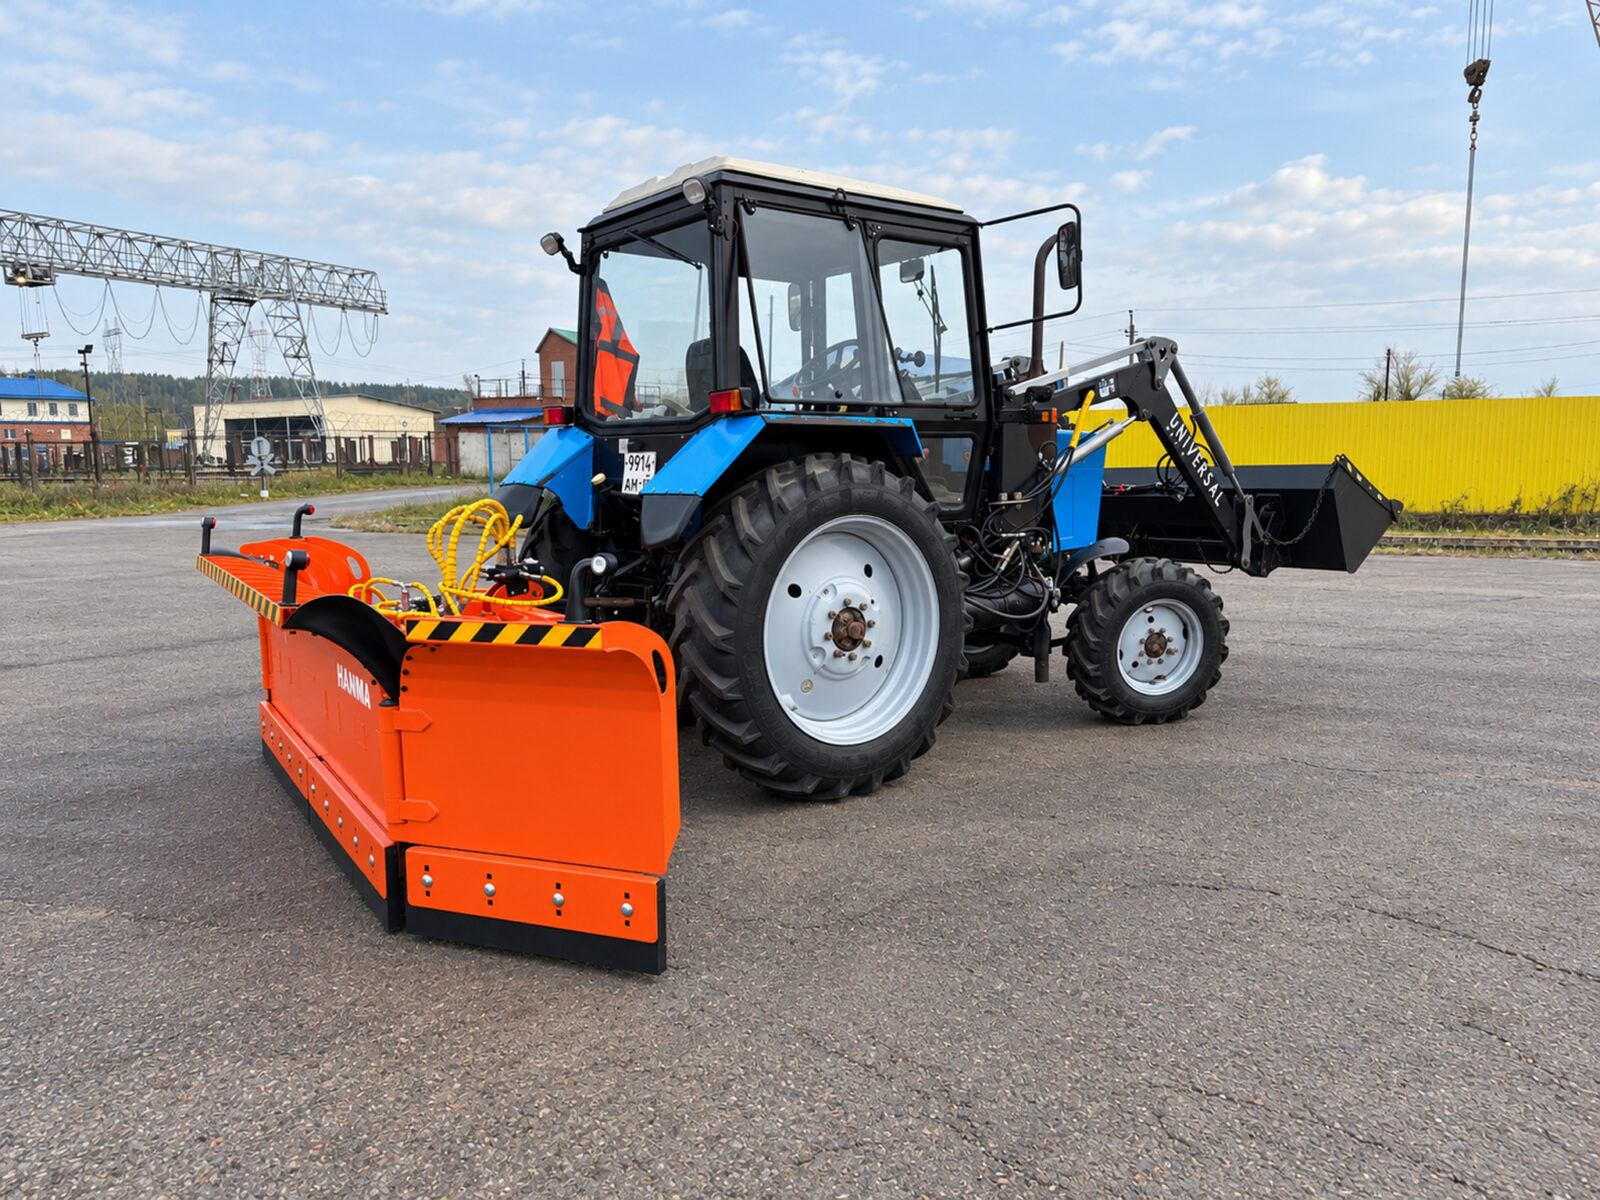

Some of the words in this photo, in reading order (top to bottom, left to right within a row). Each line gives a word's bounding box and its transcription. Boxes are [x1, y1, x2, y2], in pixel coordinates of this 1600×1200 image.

[628, 454, 651, 472] 9914
[1169, 412, 1224, 507] UNIVERSAL
[336, 662, 371, 710] HANMA
